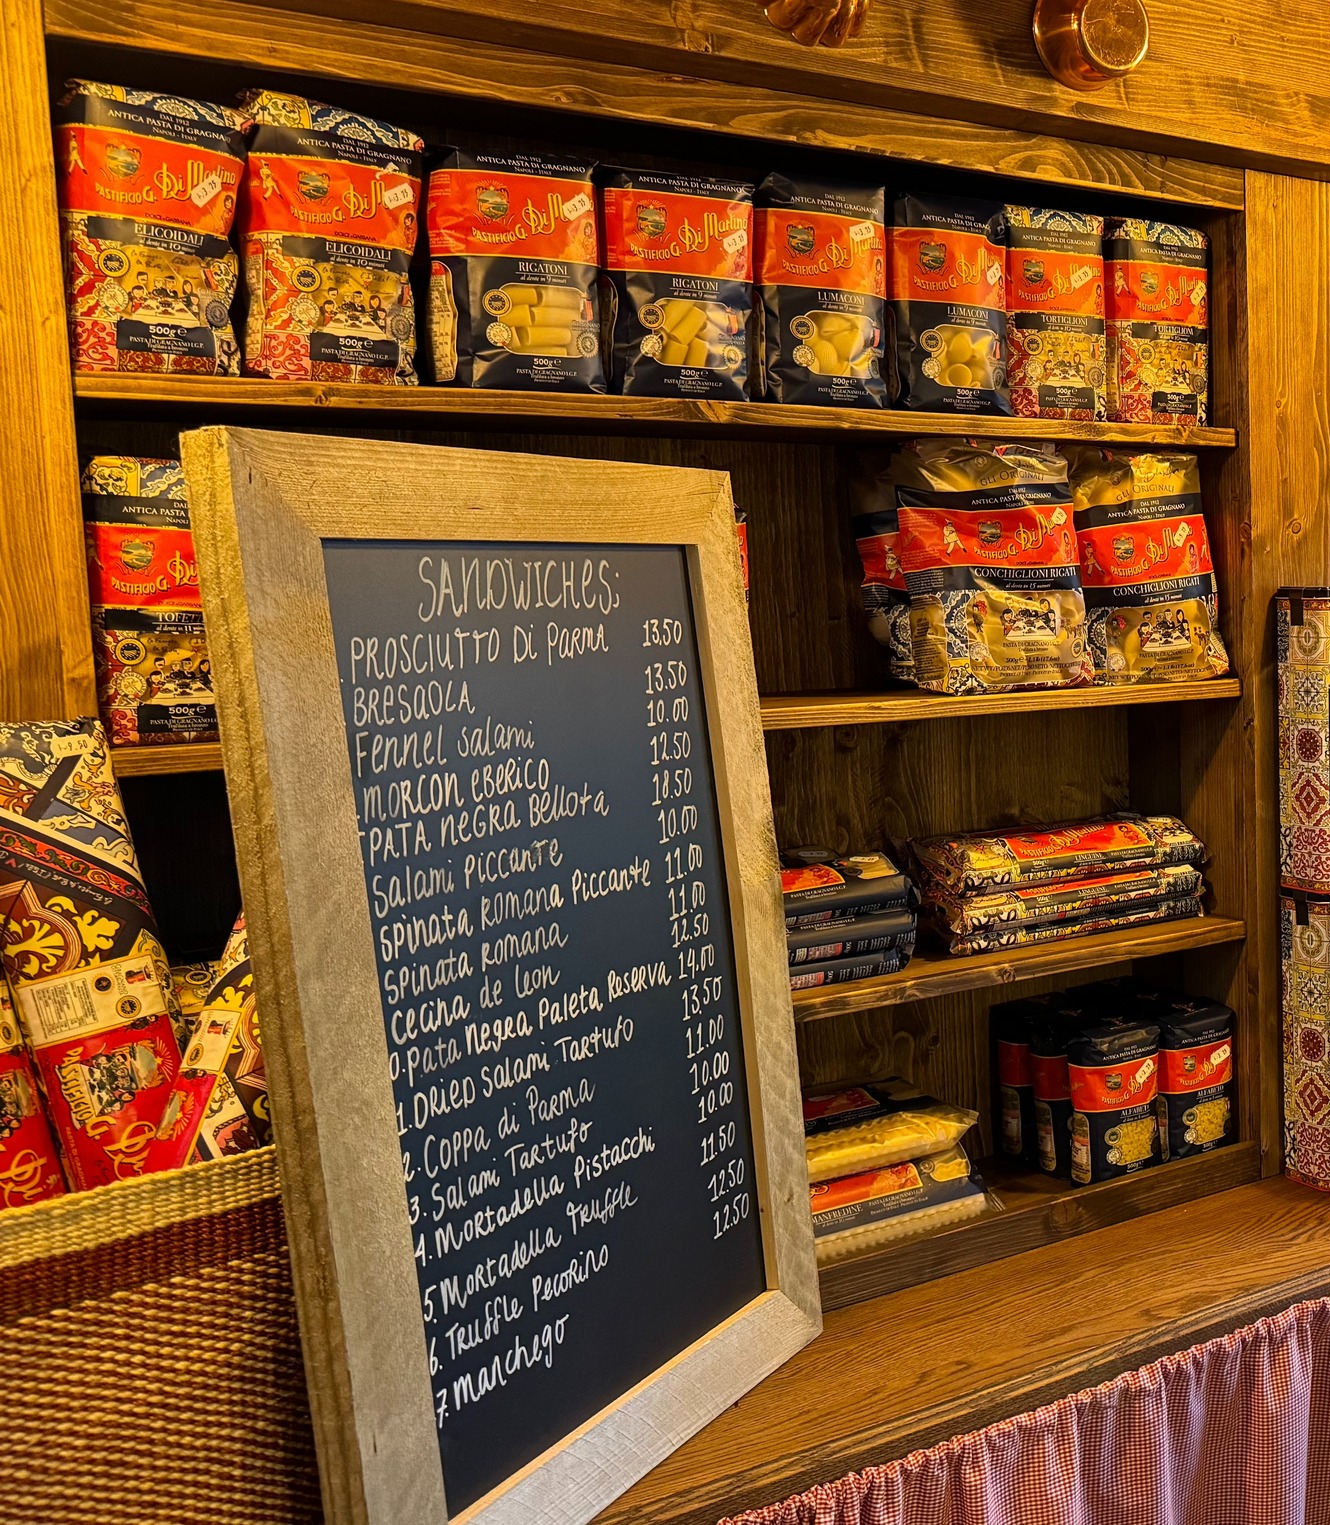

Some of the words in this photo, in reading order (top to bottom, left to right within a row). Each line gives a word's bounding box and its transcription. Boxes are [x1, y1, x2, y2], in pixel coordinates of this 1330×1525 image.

[108, 109, 144, 123] ANTICA
[146, 117, 173, 129] PASTA
[175, 124, 184, 132] DI
[297, 138, 330, 148] ANTICA
[332, 142, 354, 153] PASTA
[367, 149, 412, 165] GRAGNANO
[477, 156, 506, 165] ANTICA
[508, 159, 529, 167] PASTA
[541, 164, 586, 173] GRAGNANO
[639, 176, 667, 184] ANTICA
[668, 179, 689, 187] PASTA
[135, 223, 204, 245] ELICOIDALI
[472, 227, 515, 244] PASTIFICIO
[325, 242, 391, 261] ELICOIDALI
[630, 242, 670, 260] PASTIFICIO
[519, 262, 567, 274] RIGATONI
[672, 278, 718, 291] RIGATONI
[818, 292, 865, 305] LUMACONI
[947, 307, 989, 320] LUMACONI
[1041, 315, 1088, 326] TORTIGLIONI
[1132, 484, 1174, 493] ORIGINALI
[122, 506, 157, 515] ANTICA
[160, 508, 186, 517] PASTA
[111, 576, 156, 595] PASTIFICIO
[974, 567, 1048, 578] CONCHIGLIONI
[1050, 566, 1076, 577] RIGATI
[1113, 580, 1178, 596] CONCHIGLIONI
[1179, 577, 1199, 587] RIGATI
[642, 618, 683, 648] 13.50
[351, 627, 500, 684] PROSCIUTTO
[645, 661, 687, 695] 13.50
[647, 696, 689, 727] 10.00
[355, 725, 447, 778] Fennel
[650, 731, 692, 766] 12.50
[657, 804, 699, 845] 10.00
[370, 821, 431, 867] PATA
[665, 843, 703, 884] 11.00
[668, 881, 706, 921] 11.00
[670, 912, 710, 949] 12.50
[480, 975, 503, 1010] de
[681, 976, 723, 1021] 13.50
[685, 1014, 725, 1059] 11.00
[689, 1050, 731, 1096] 10.00
[697, 1082, 735, 1124] 10.00
[700, 1121, 736, 1167] 11.50
[707, 1158, 746, 1203] 12.50
[712, 1192, 750, 1240] 12.50
